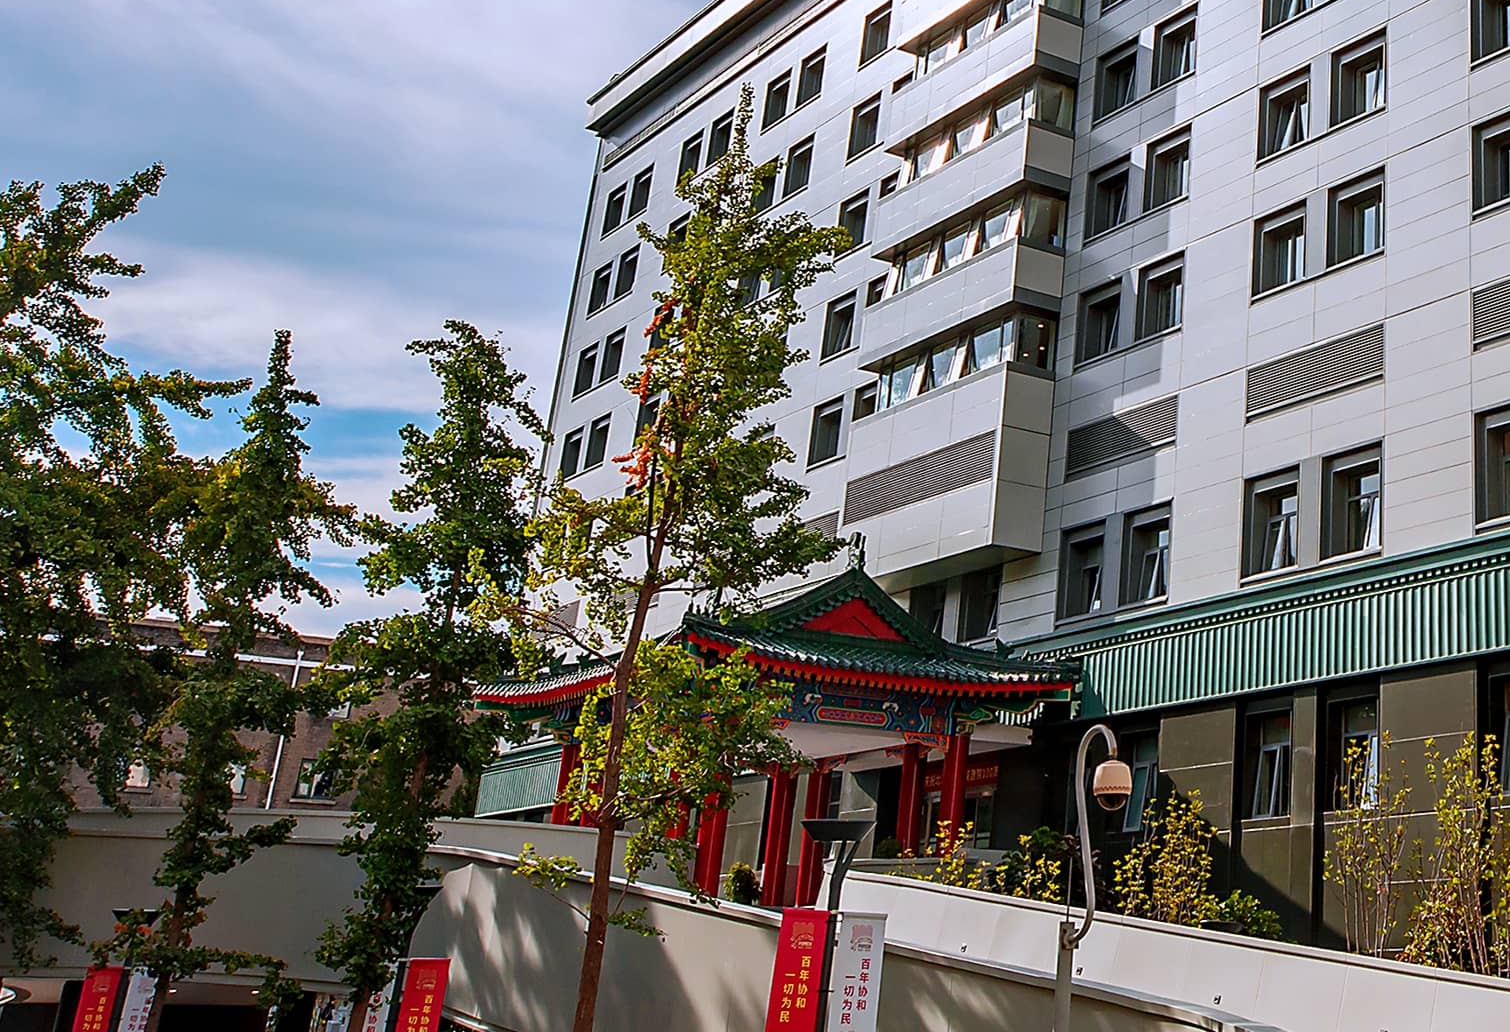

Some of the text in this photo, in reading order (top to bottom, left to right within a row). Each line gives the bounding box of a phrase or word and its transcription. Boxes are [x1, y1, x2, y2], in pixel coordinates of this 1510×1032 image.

[779, 973, 796, 1022] 一切为民
[795, 956, 812, 1008] 百年协和
[840, 975, 856, 1024] 一切为民
[856, 959, 872, 1010] 百年协和
